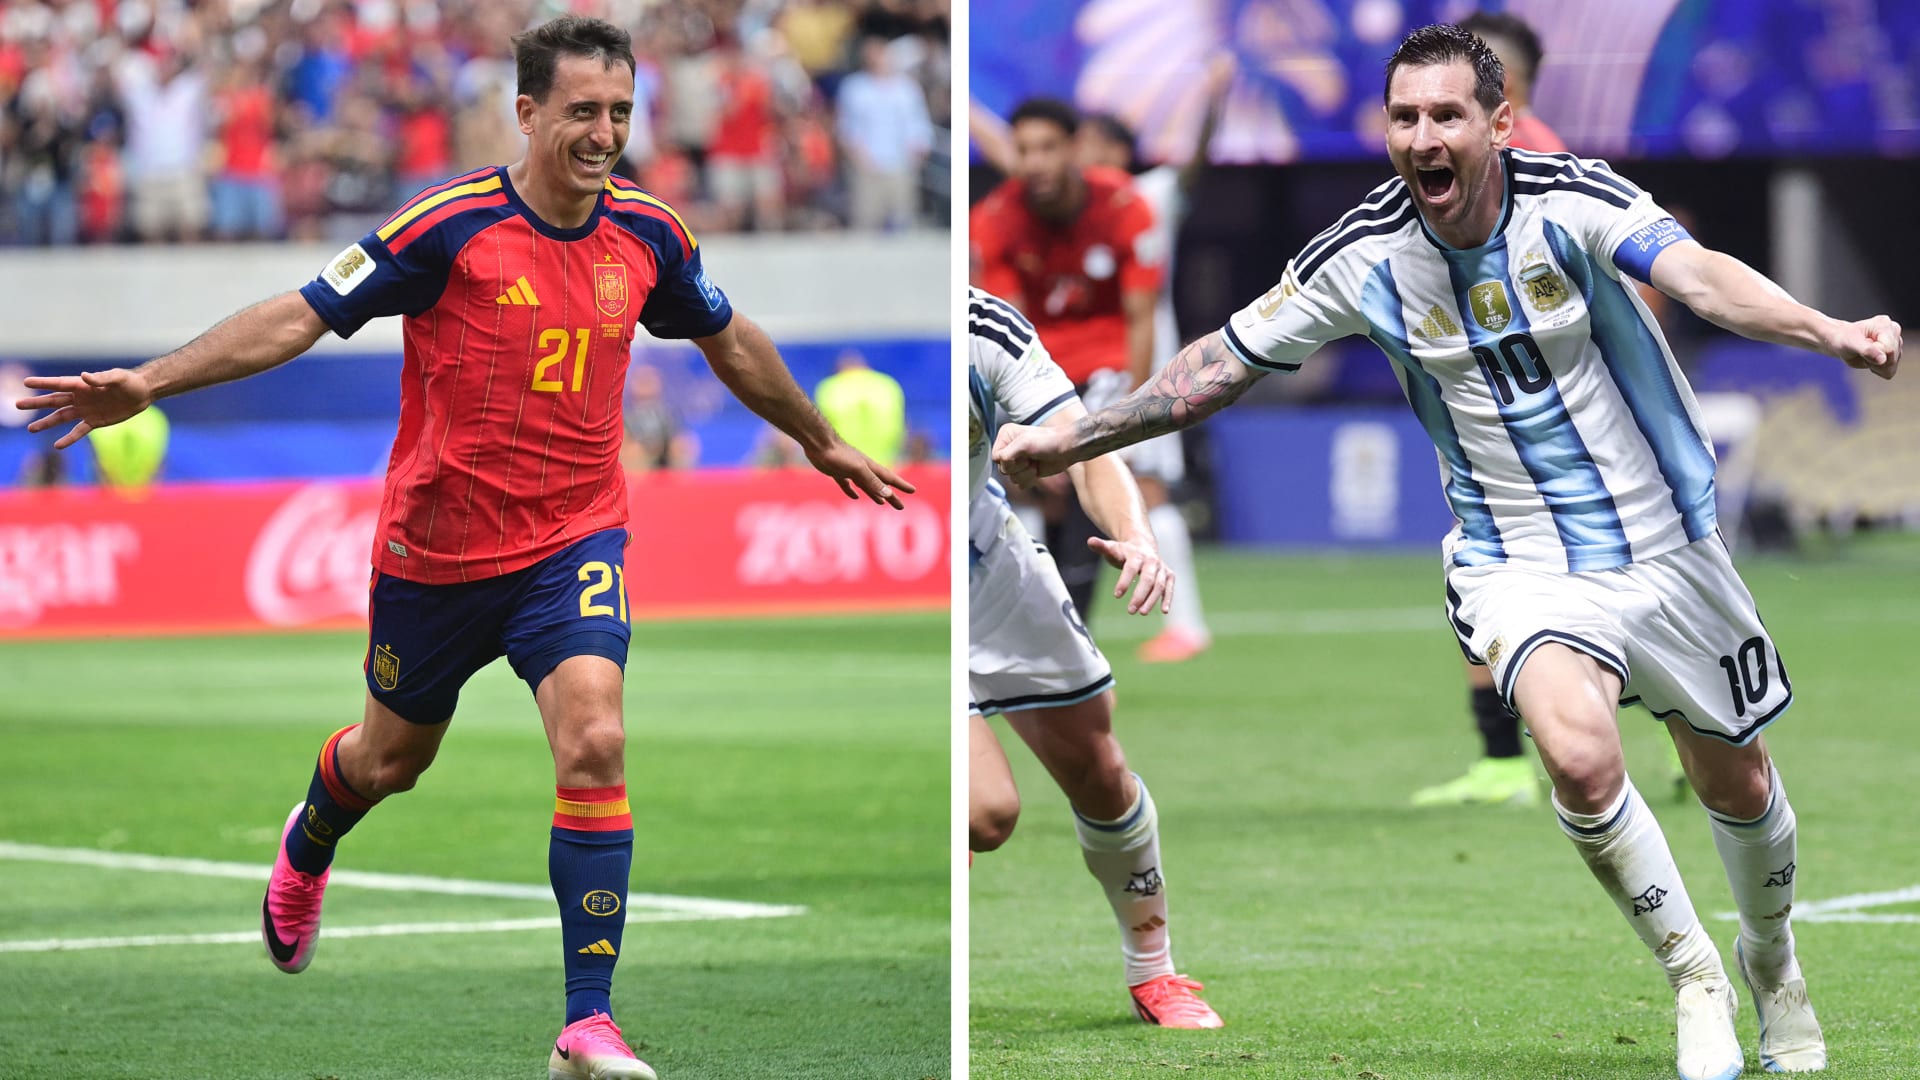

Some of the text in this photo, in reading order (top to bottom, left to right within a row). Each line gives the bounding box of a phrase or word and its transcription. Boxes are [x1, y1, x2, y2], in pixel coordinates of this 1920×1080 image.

[1631, 219, 1674, 244] UNITES
[1532, 276, 1558, 298] AFA
[1485, 314, 1504, 324] FIFA
[531, 328, 590, 392] 21
[1471, 333, 1553, 405] 10
[734, 500, 943, 584] zero
[578, 561, 627, 624] 21
[1719, 636, 1768, 717] 10
[1631, 884, 1668, 916] AFA
